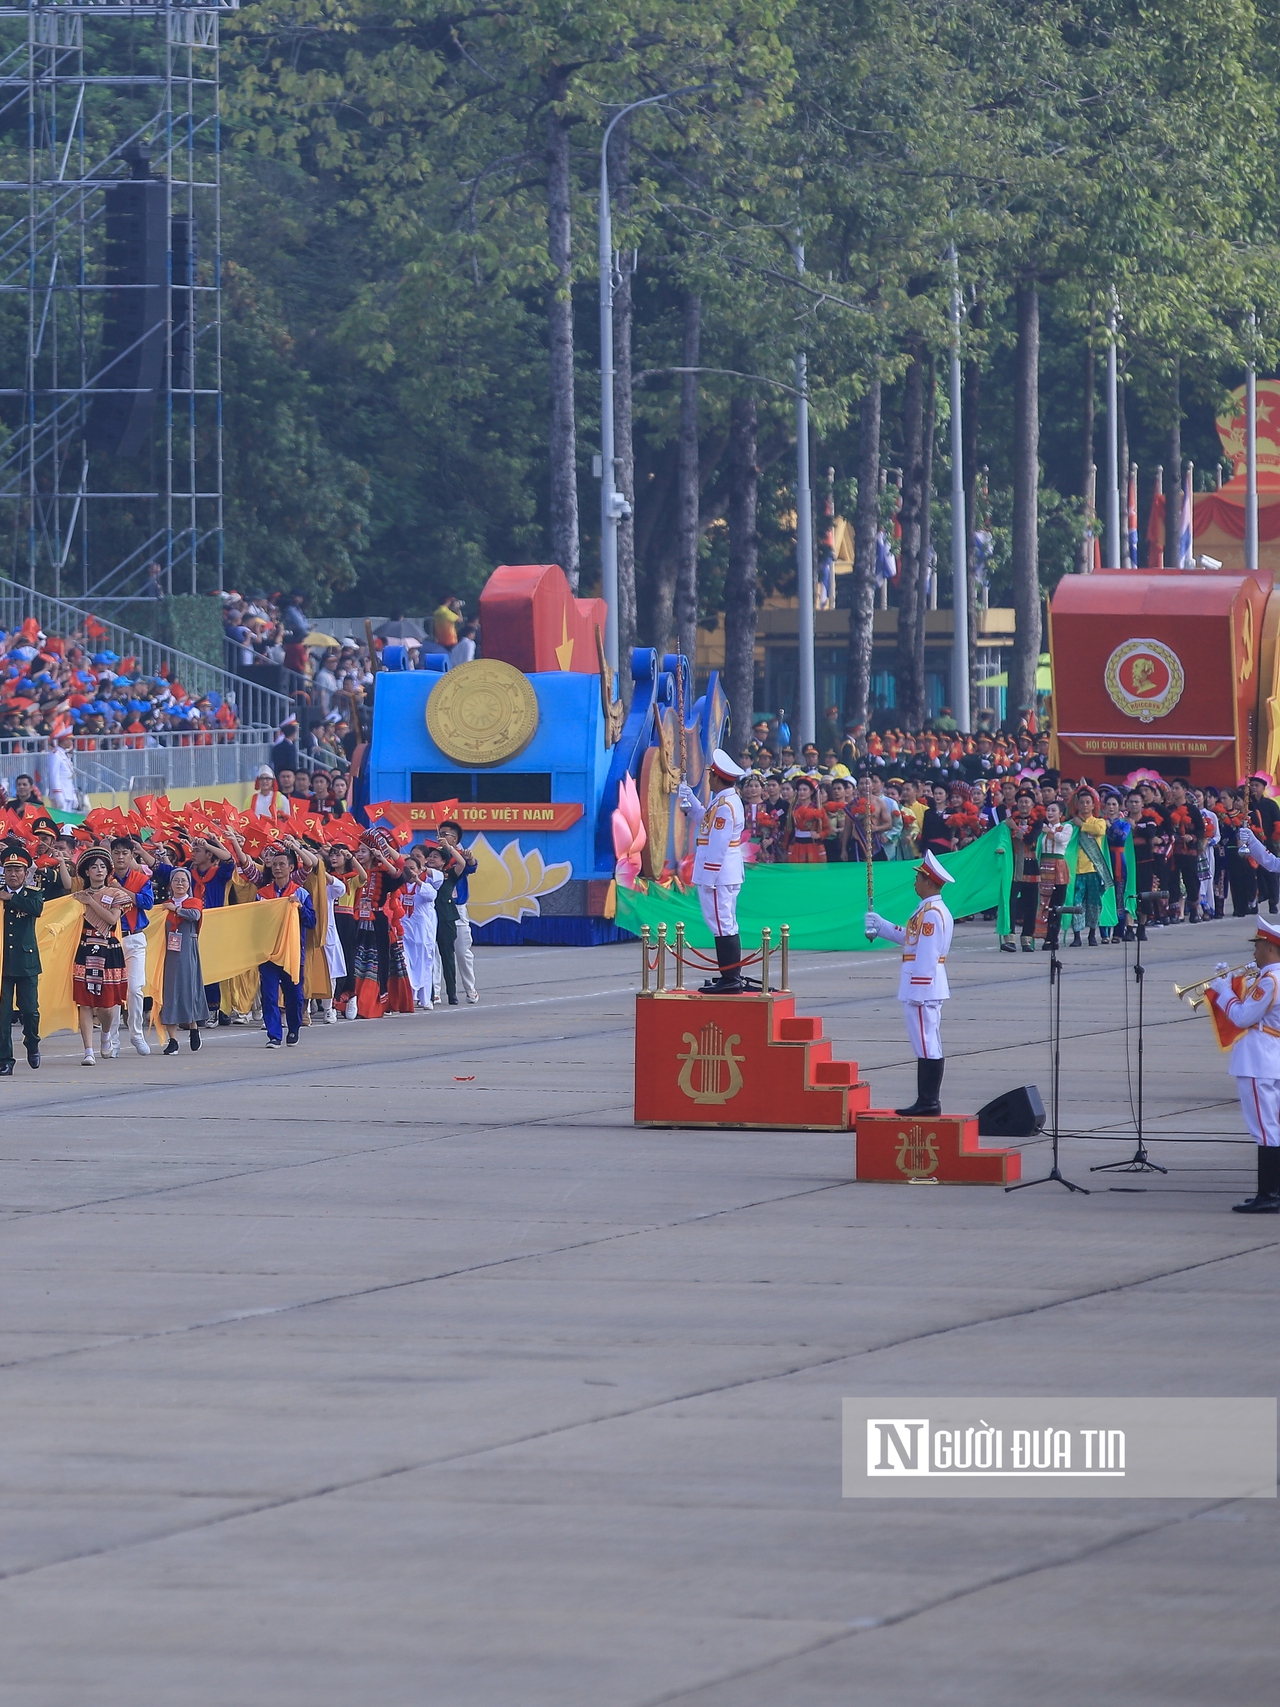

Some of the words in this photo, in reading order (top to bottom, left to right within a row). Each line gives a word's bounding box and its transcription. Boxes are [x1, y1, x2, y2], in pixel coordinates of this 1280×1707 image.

[1147, 741, 1168, 751] BINH
[1188, 743, 1208, 752] NAM
[410, 809, 427, 820] 54
[462, 806, 488, 823] TỘC
[491, 806, 519, 823] VIỆT
[523, 809, 554, 820] NAM
